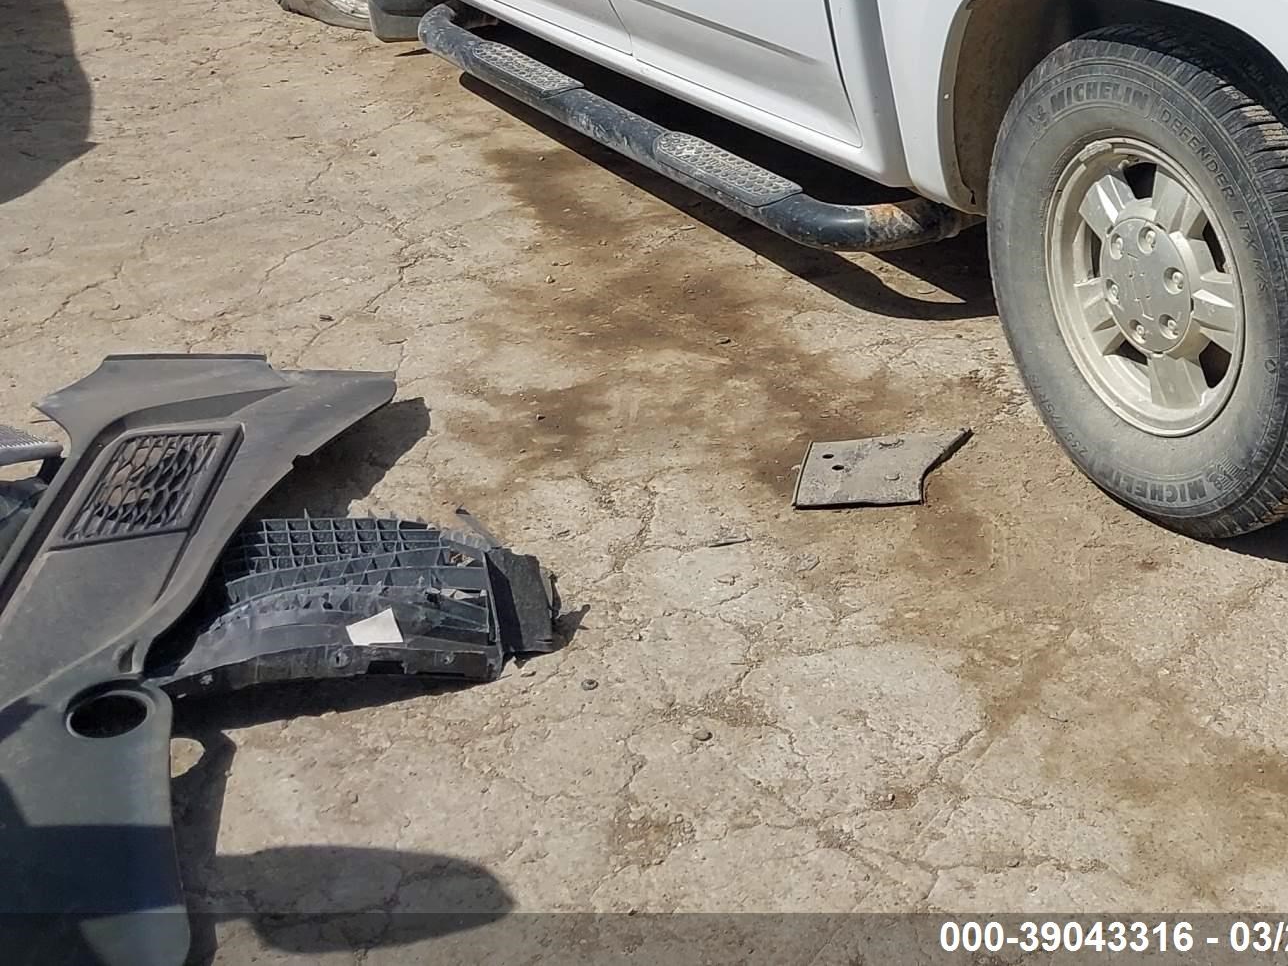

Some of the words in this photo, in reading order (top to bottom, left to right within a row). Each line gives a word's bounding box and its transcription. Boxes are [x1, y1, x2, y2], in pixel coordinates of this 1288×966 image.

[1050, 80, 1149, 113] MICHELIN
[1160, 107, 1236, 201] DEFENDER
[1232, 209, 1260, 250] LTX
